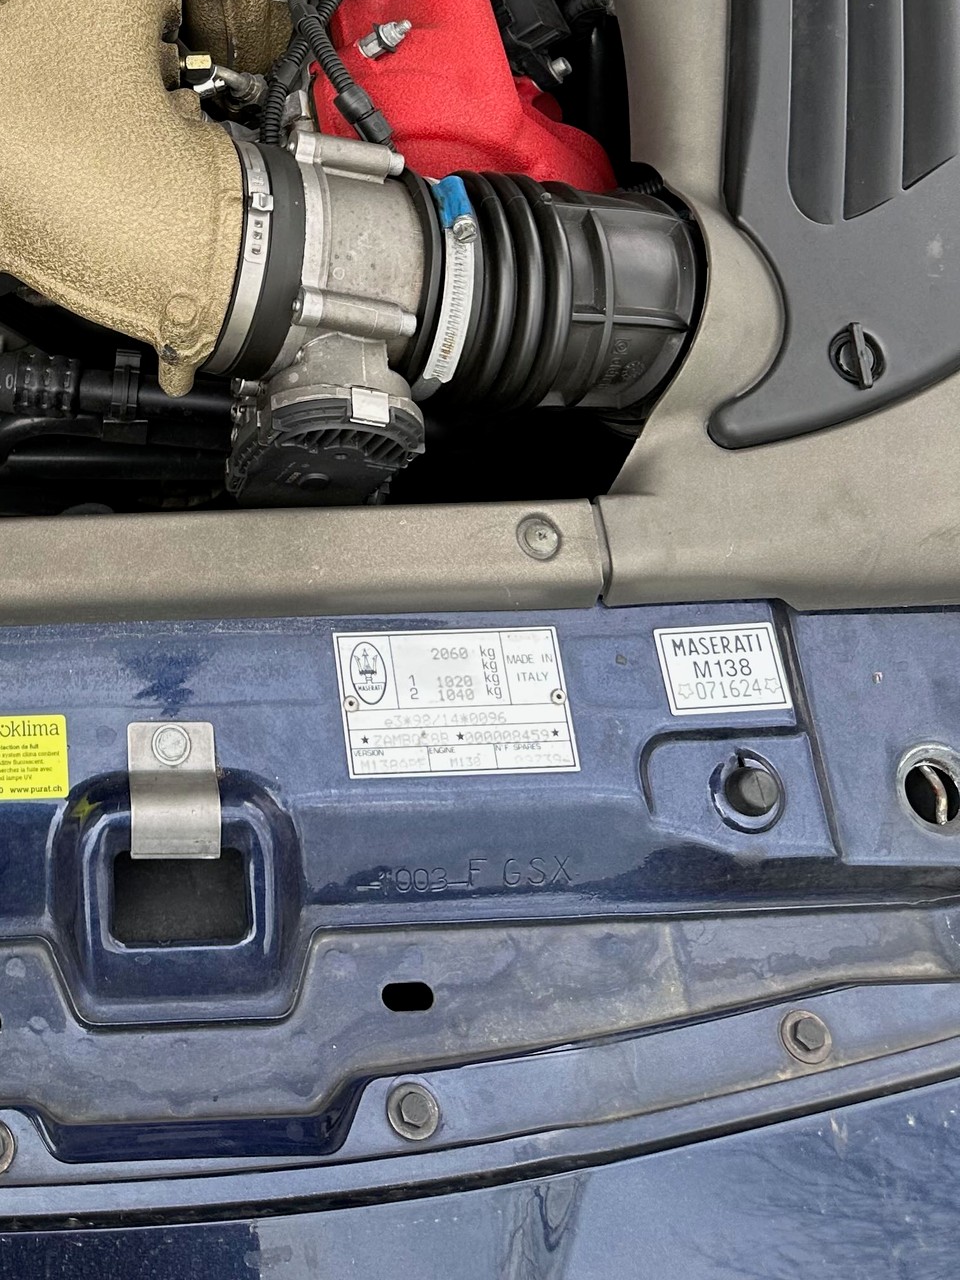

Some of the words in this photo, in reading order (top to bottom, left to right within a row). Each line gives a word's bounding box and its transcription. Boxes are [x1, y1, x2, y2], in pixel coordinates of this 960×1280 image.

[431, 646, 469, 660] 2060
[480, 645, 496, 660] kg
[672, 634, 762, 657] MASERATI
[482, 658, 498, 671] kg
[506, 654, 534, 665] MADE
[541, 653, 553, 663] IN
[693, 658, 752, 679] M138
[408, 674, 416, 687] 1
[436, 675, 473, 688] 1020
[485, 672, 500, 686] kg
[517, 672, 549, 682] ITALY
[410, 687, 419, 700] 2
[438, 688, 475, 701] 1040
[487, 684, 503, 699] kg
[695, 678, 762, 700] 071624
[353, 748, 384, 756] VERSION
[10, 785, 62, 794] www.purat.ch
